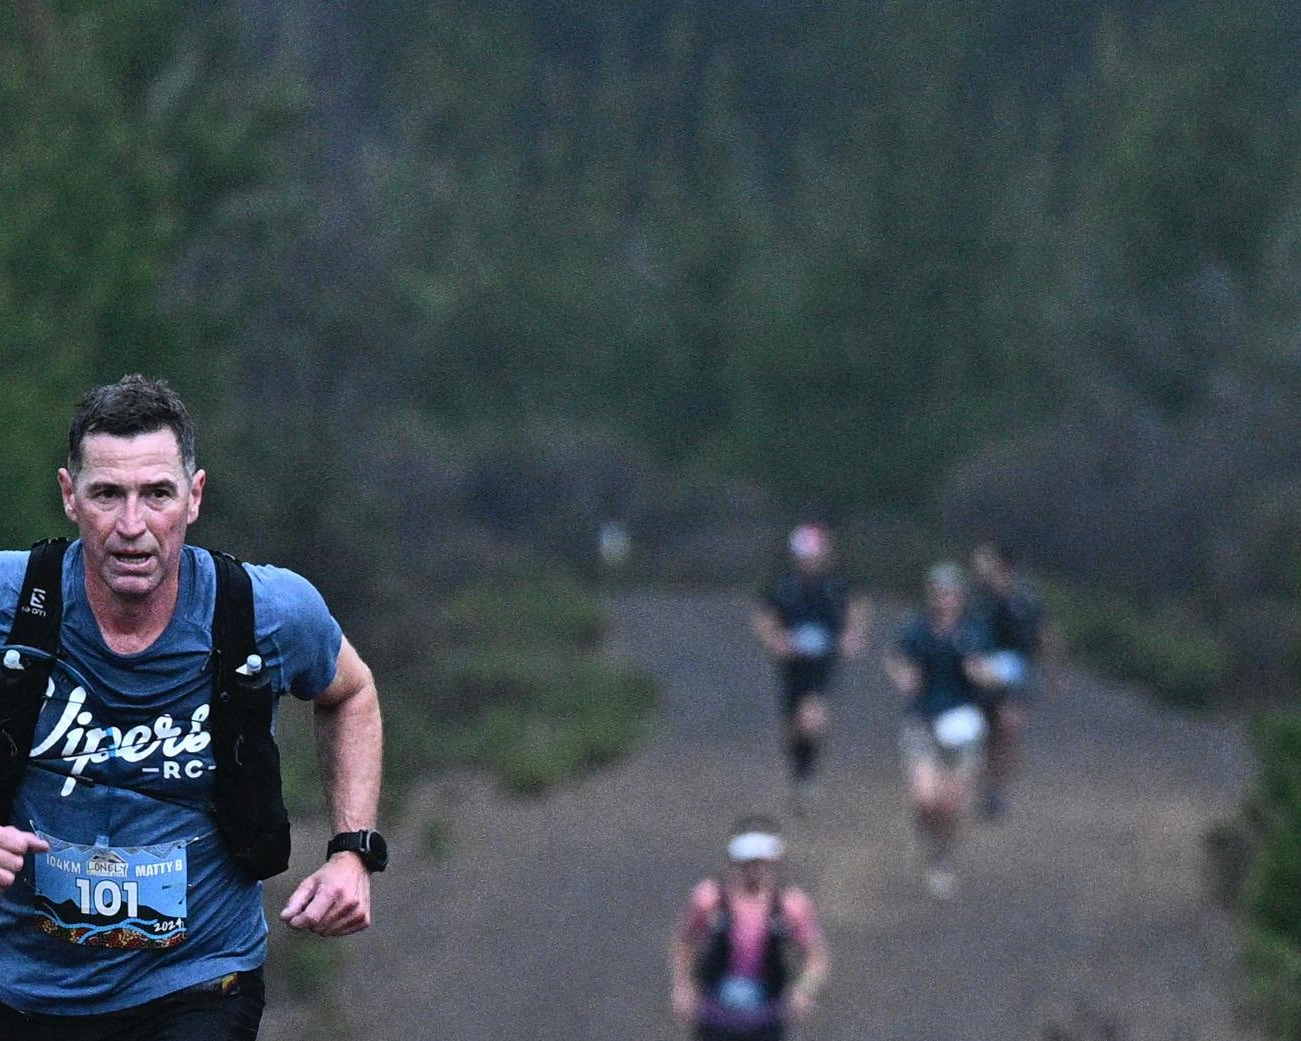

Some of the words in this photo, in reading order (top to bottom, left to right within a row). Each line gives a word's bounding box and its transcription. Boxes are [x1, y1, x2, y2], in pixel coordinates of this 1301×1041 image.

[46, 854, 81, 875] 104KM
[135, 861, 174, 878] MATTY
[175, 859, 183, 872] B
[76, 878, 139, 918] 101
[153, 918, 183, 933] 2024
